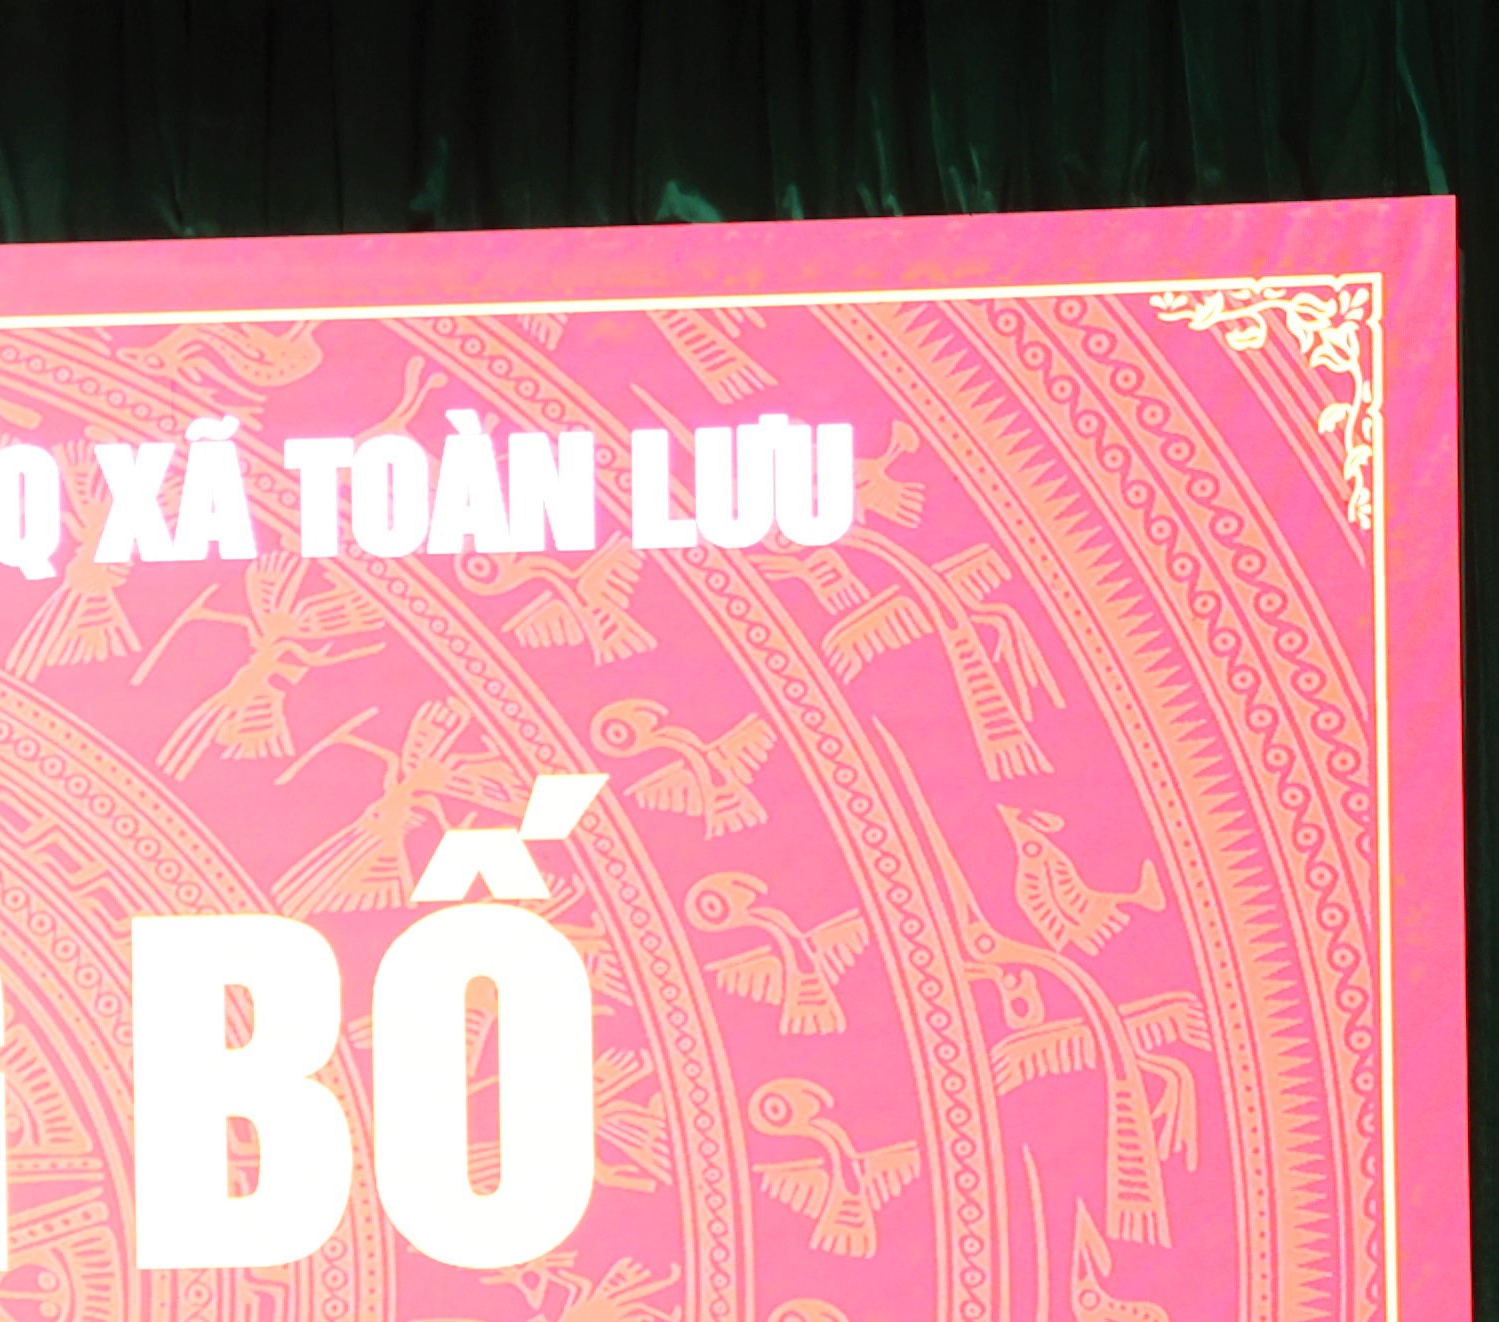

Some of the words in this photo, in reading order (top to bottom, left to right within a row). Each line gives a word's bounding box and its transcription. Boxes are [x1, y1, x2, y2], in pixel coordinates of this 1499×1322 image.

[94, 416, 258, 563] XÃ
[284, 409, 595, 557] TOÀN
[631, 413, 854, 549] LƯU
[132, 774, 608, 1268] BỐ
